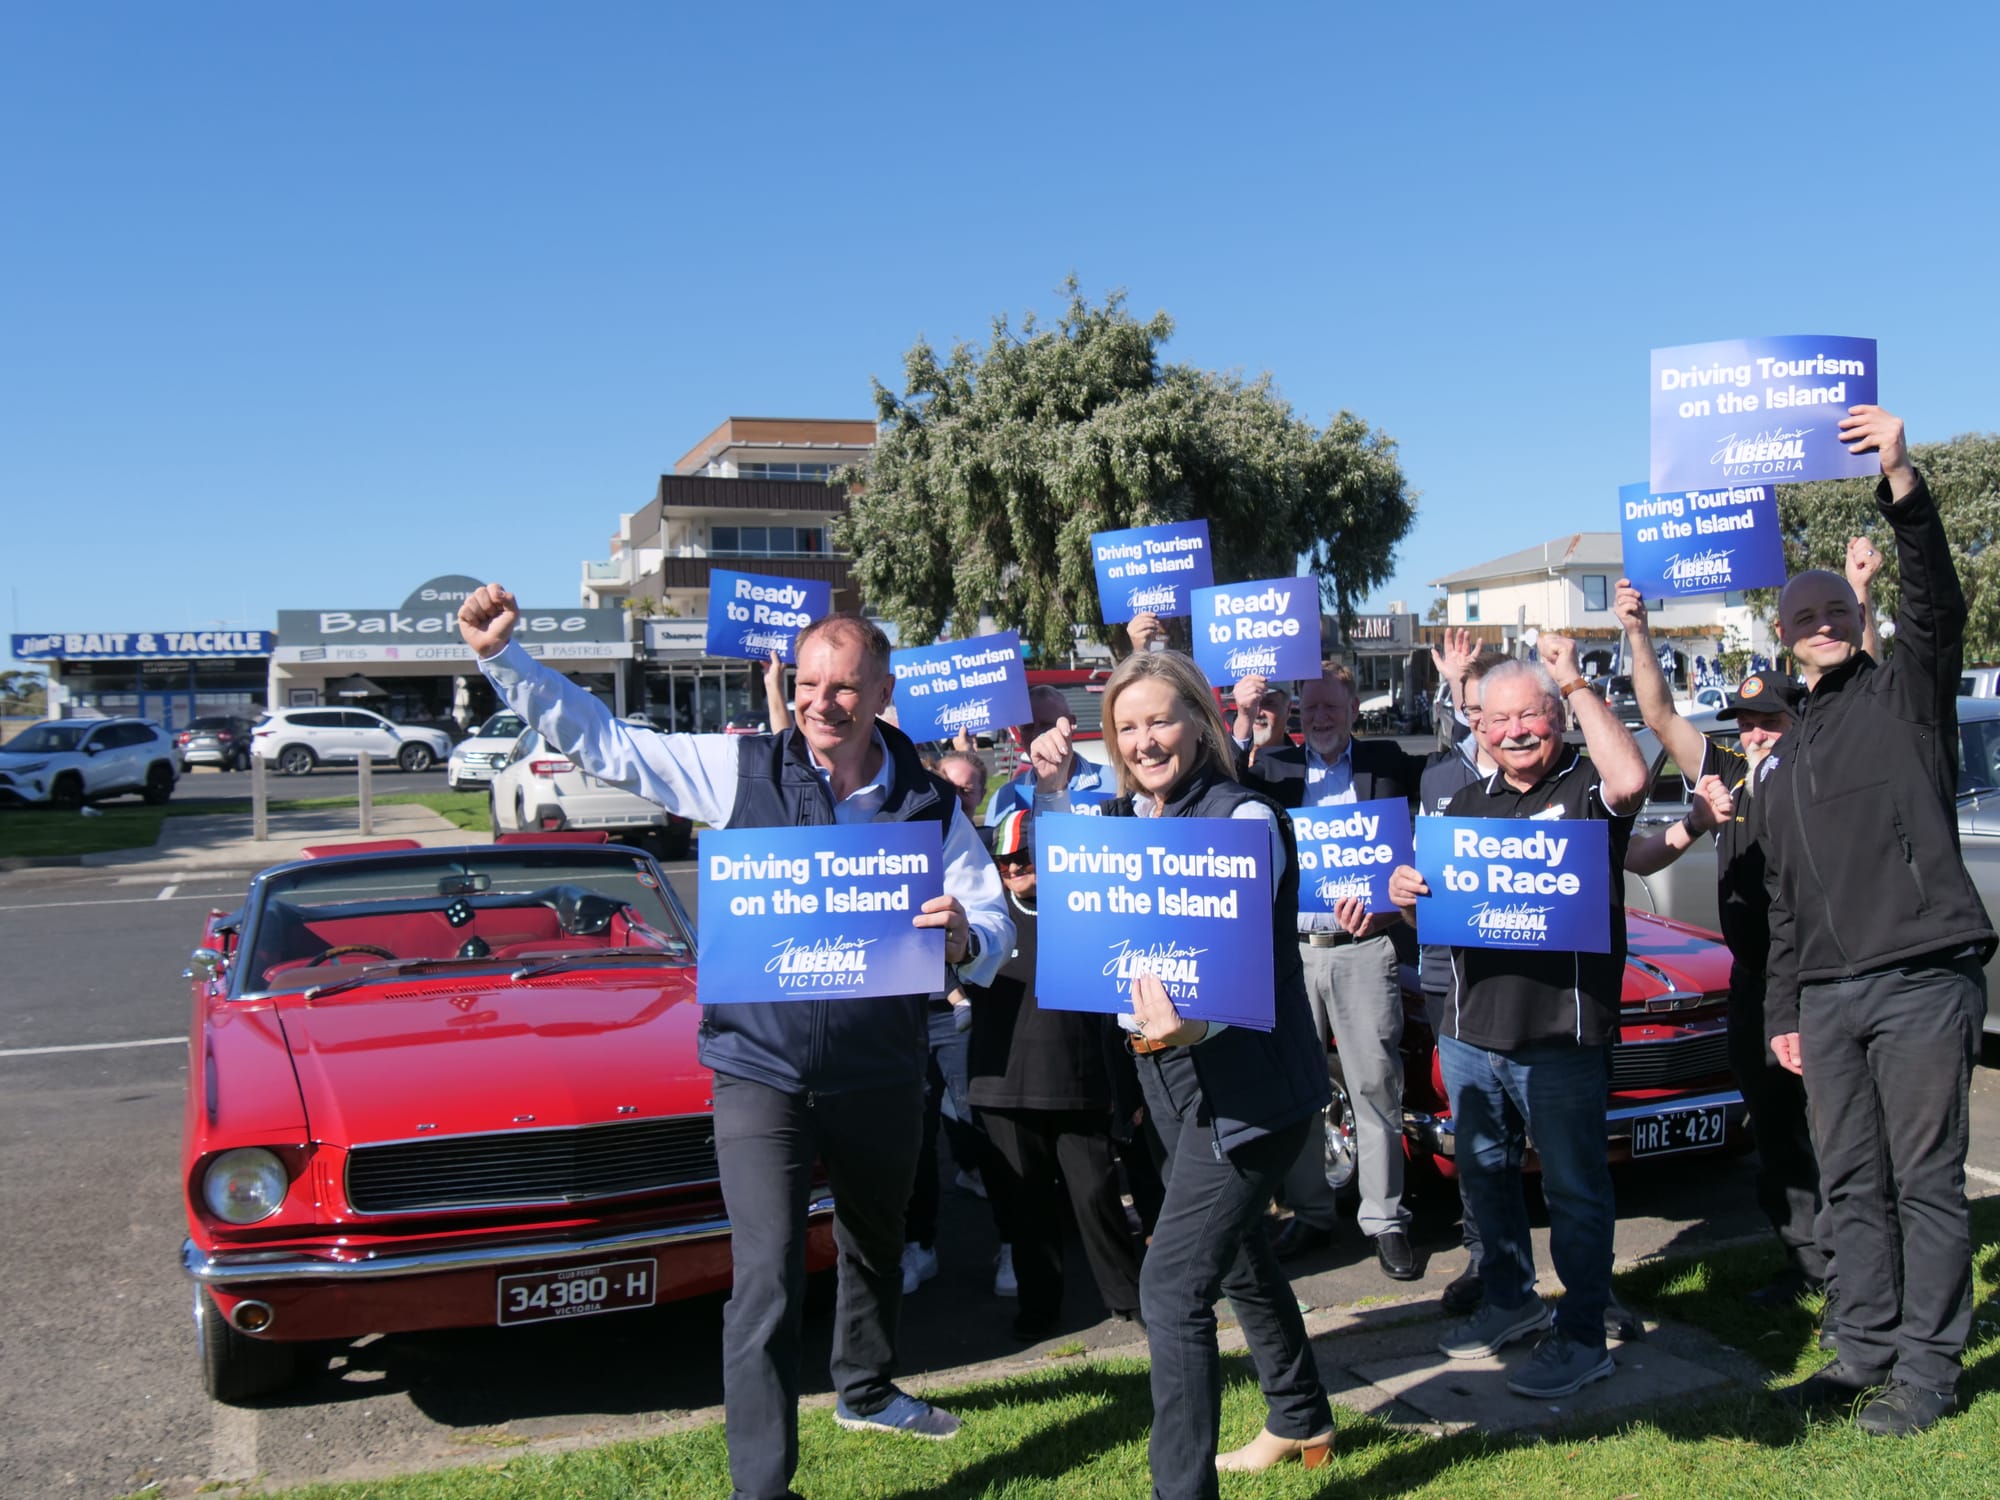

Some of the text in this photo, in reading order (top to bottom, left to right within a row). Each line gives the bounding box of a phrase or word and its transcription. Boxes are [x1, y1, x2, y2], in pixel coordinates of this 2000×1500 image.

[1660, 354, 1865, 391] Driving Tourism
[1679, 382, 1846, 418] on the Island
[1723, 440, 1805, 464] LIBERAL
[1722, 460, 1803, 477] VICTORIA
[1625, 485, 1765, 521] Driving Tourism
[1637, 510, 1754, 543] on the Island
[1097, 536, 1203, 562] Driving Tourism
[1108, 555, 1194, 579] on the Island
[1672, 559, 1731, 579] LIBERAL
[1673, 574, 1732, 589] VICTORIA
[735, 579, 807, 609] Ready
[1132, 590, 1176, 607] LIBERAL
[1215, 588, 1291, 616] Ready
[727, 601, 812, 628] to Race
[1133, 603, 1176, 615] VICTORIA
[1208, 618, 1300, 644] to Race
[17, 632, 262, 655] Jim's BAIT & TACKLE
[415, 647, 469, 659] COFFEE
[552, 645, 613, 657] PASTRIES
[746, 636, 788, 651] LIBERAL
[895, 648, 1015, 680] Driving Tourism
[1231, 652, 1277, 669] LIBERAL
[1231, 665, 1276, 678] VICTORIA
[909, 667, 1007, 697] on the Island
[943, 705, 990, 725] LIBERAL
[1294, 811, 1379, 841] Ready
[1321, 844, 1393, 868] Race
[1453, 828, 1569, 867] Ready
[710, 848, 928, 885] Driving Tourism
[1047, 844, 1256, 882] Driving Tourism
[1322, 881, 1372, 898] LIBERAL
[1443, 864, 1580, 895] to Race
[730, 884, 909, 916] on the Island
[1068, 885, 1238, 919] on the Island
[1478, 911, 1548, 931] LIBERAL
[1478, 928, 1547, 941] VICTORIA
[779, 950, 867, 974] LIBERAL
[1117, 956, 1200, 984] LIBERAL
[778, 972, 865, 988] VICTORIA
[555, 1303, 601, 1316] VICTORIA
